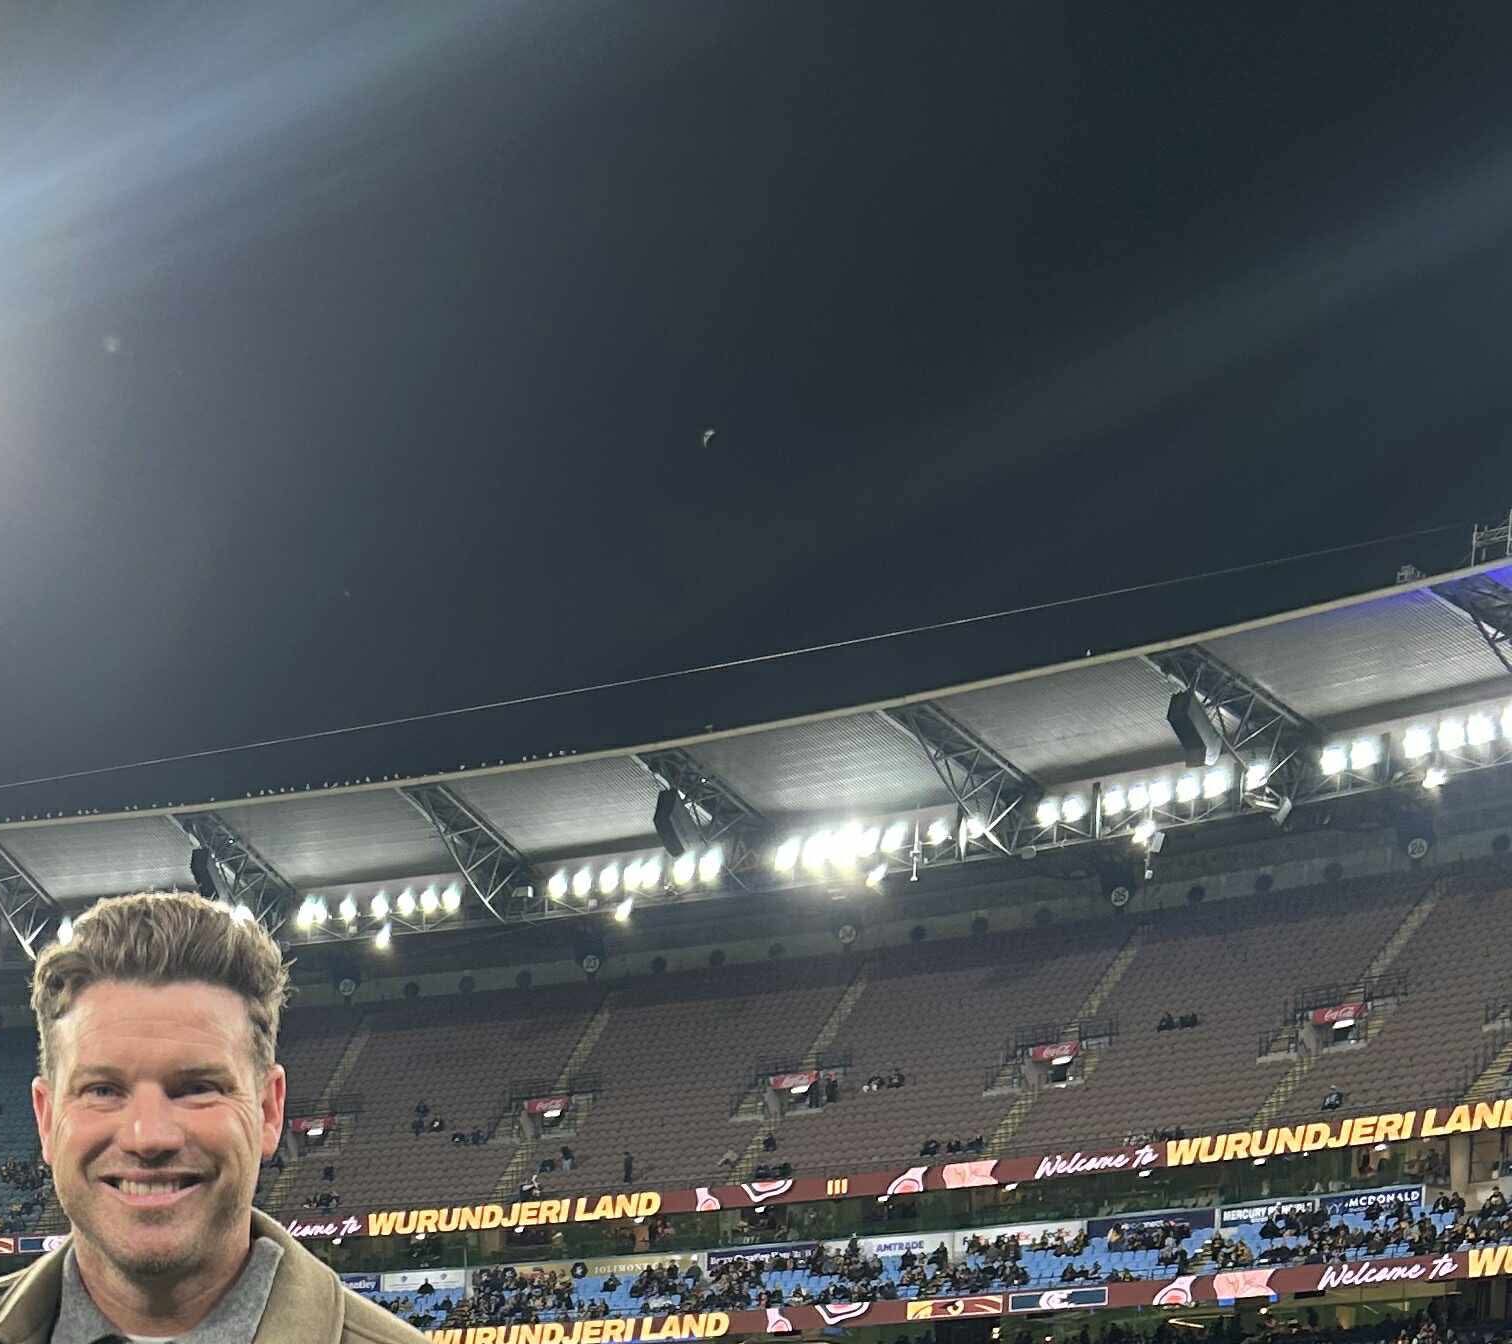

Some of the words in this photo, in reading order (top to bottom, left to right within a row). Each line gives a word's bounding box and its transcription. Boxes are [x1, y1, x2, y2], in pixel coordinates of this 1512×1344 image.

[1034, 1149, 1130, 1179] Welcome
[1132, 1145, 1160, 1168] to
[1166, 1111, 1416, 1167] WURUNDJERI
[285, 1217, 338, 1239] lcome
[340, 1215, 362, 1237] to
[367, 1198, 571, 1236] WURUNDJERI
[574, 1191, 661, 1222] LAND
[1317, 1261, 1426, 1290] Welcome
[1428, 1253, 1459, 1280] to
[638, 1312, 730, 1342] LAND
